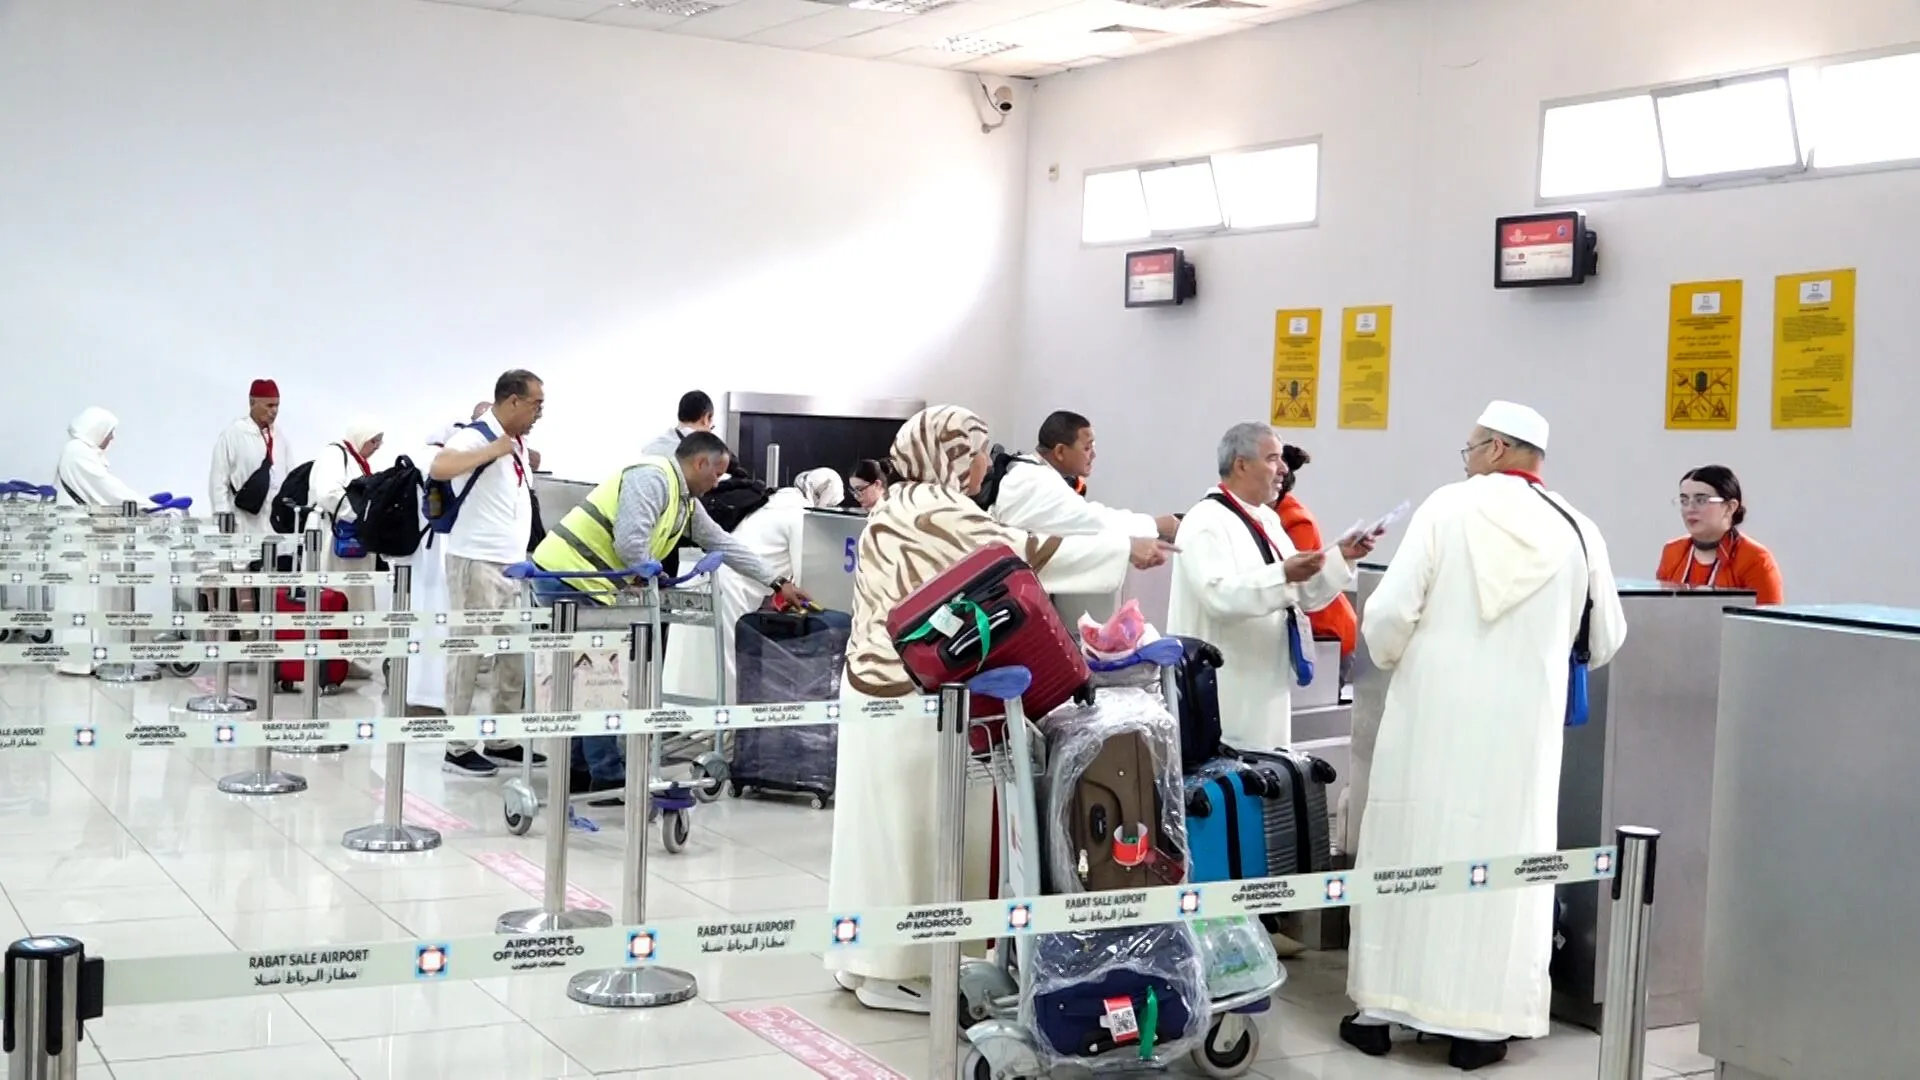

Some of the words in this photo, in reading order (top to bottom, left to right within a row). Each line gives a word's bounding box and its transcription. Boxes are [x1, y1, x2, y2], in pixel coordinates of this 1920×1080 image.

[844, 537, 856, 573] 5
[906, 905, 963, 920] AIRPORTS
[697, 924, 728, 938] RABAT
[730, 923, 753, 935] SALE
[755, 919, 796, 933] AIRPORT
[896, 921, 912, 931] OF
[914, 915, 972, 929] MOROCCO
[505, 935, 575, 949] AIRPORTS
[249, 955, 287, 968] RABAT
[289, 952, 317, 966] SALE
[320, 949, 370, 964] AIRPORT
[493, 951, 512, 961] OF
[514, 945, 585, 959] MOROCCO
